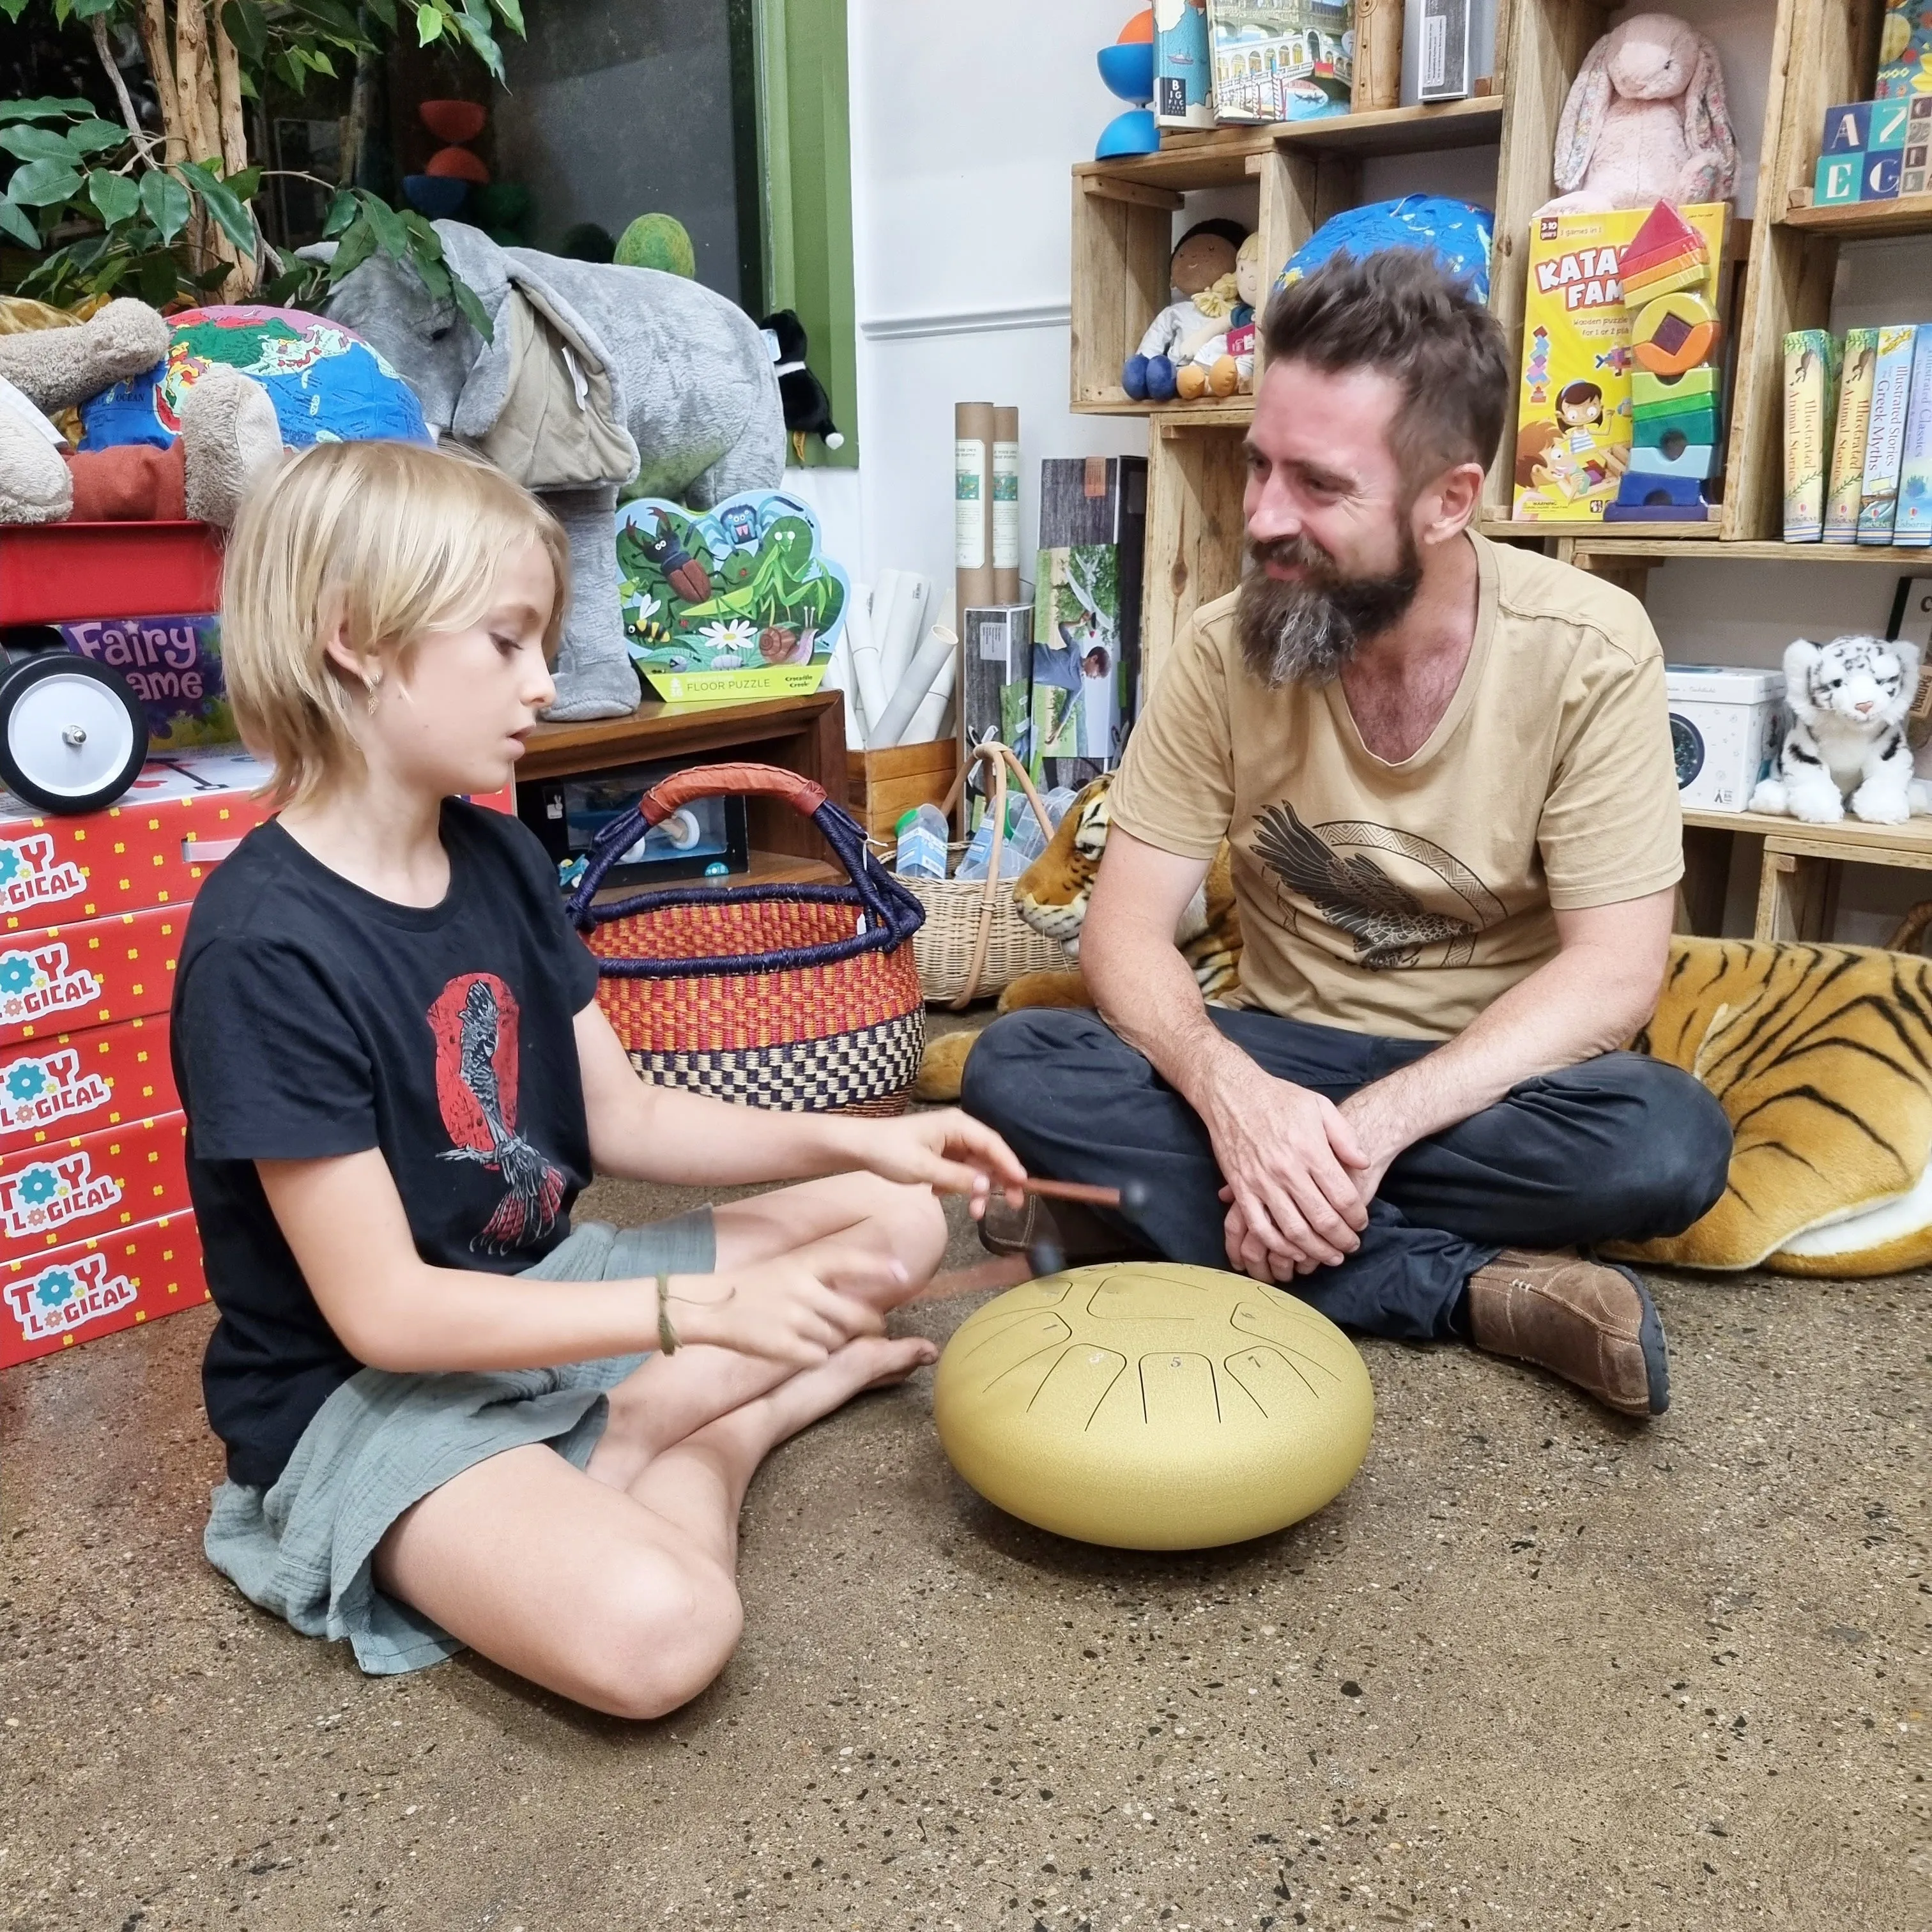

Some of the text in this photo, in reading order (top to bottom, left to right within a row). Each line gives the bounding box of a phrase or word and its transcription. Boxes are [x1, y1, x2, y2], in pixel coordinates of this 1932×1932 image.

[1170, 90, 1182, 99] IG
[1172, 80, 1179, 91] B
[1830, 107, 1908, 149] A Z
[1825, 164, 1851, 199] E
[1565, 228, 1588, 237] games
[116, 393, 146, 402] OCEAN
[1885, 366, 1908, 467] Illustrated Stories
[1789, 390, 1800, 482] Animal Stories
[1804, 399, 1817, 469] Illustrated
[1834, 388, 1855, 480] Animal Stories
[1850, 399, 1870, 470] Illustrated
[1867, 379, 1890, 471] Greek Myths
[69, 620, 197, 670] Fairy
[687, 681, 725, 691] FLOOR
[728, 678, 771, 689] PUZZLE
[0, 977, 94, 1018] OGICAL
[0, 1055, 73, 1103] OY
[1, 1081, 104, 1127] LOGICAL
[0, 1158, 84, 1212] TOY
[12, 1182, 115, 1230] LOGICAL
[10, 1260, 100, 1315] TOY
[29, 1282, 131, 1333] LOGICAL
[1170, 1356, 1181, 1368] 5
[1248, 1356, 1261, 1368] 7
